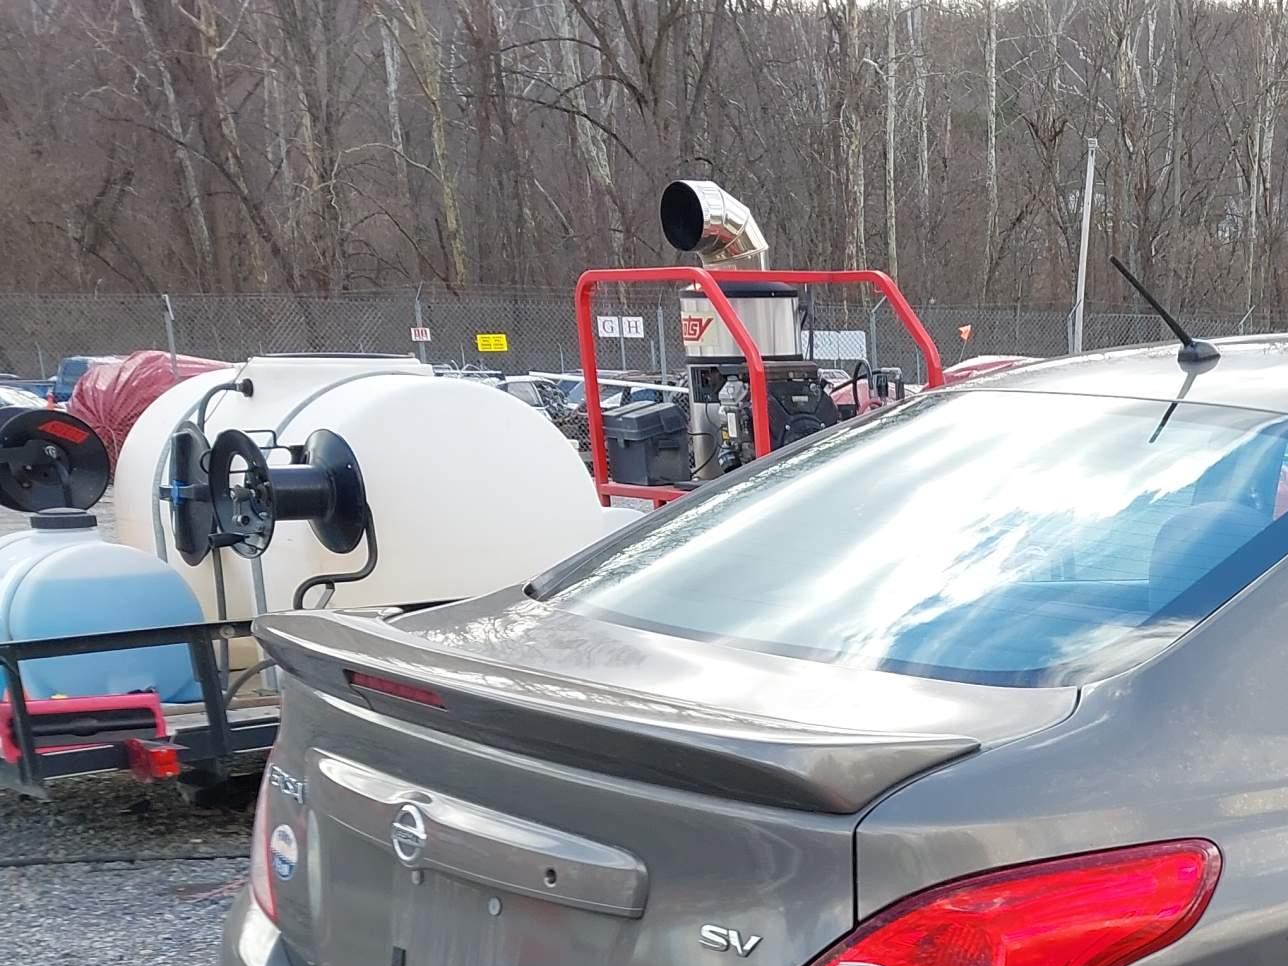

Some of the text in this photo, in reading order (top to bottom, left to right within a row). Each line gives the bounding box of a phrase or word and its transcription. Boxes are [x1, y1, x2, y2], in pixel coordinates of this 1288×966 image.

[602, 319, 614, 334] G
[627, 320, 641, 334] H
[699, 924, 763, 957] SV
